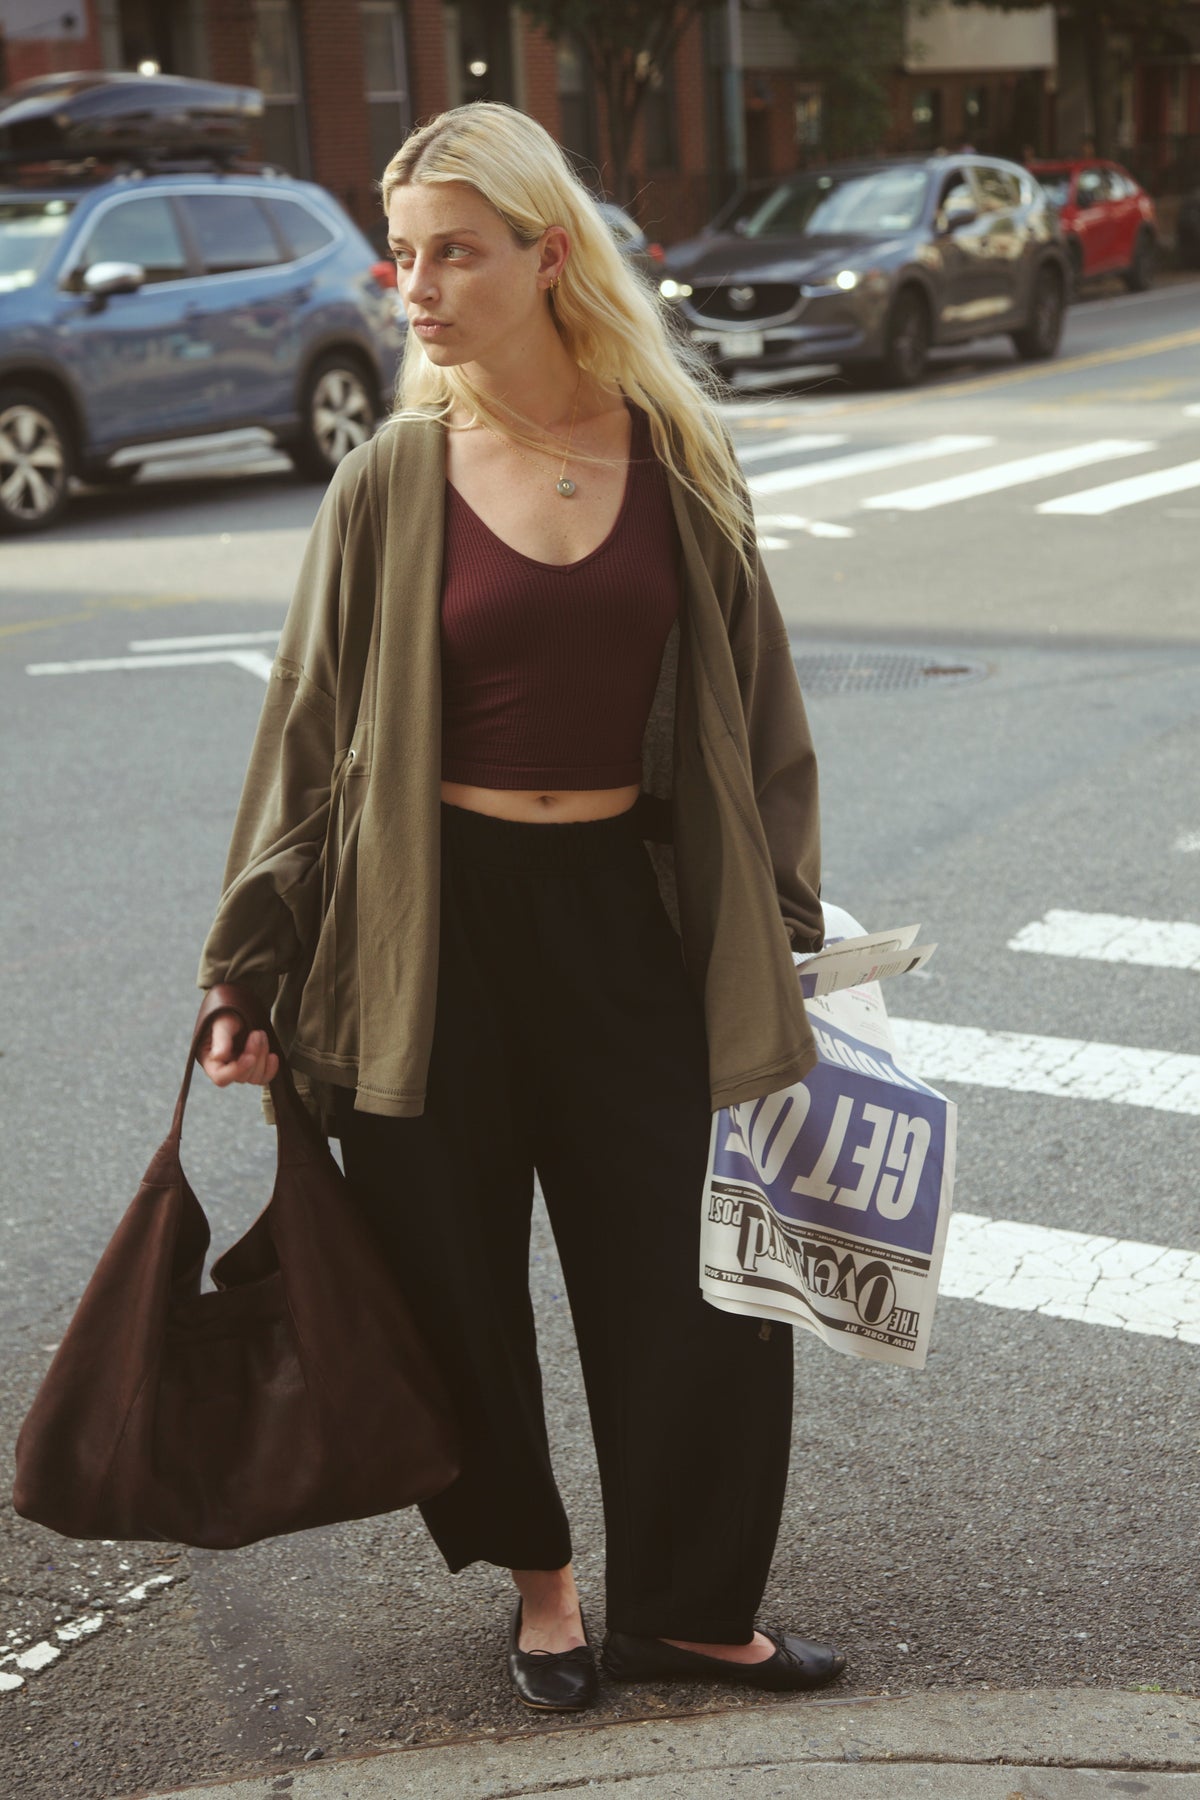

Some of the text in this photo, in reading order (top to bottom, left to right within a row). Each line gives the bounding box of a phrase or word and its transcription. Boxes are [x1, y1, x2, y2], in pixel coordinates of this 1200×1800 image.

[811, 1023, 920, 1092] YOUR
[791, 1094, 931, 1221] GET
[708, 1195, 742, 1227] POST
[721, 1272, 744, 1283] FALL
[844, 1323, 915, 1350] NEW YORK, NY
[887, 1307, 920, 1338] THE
